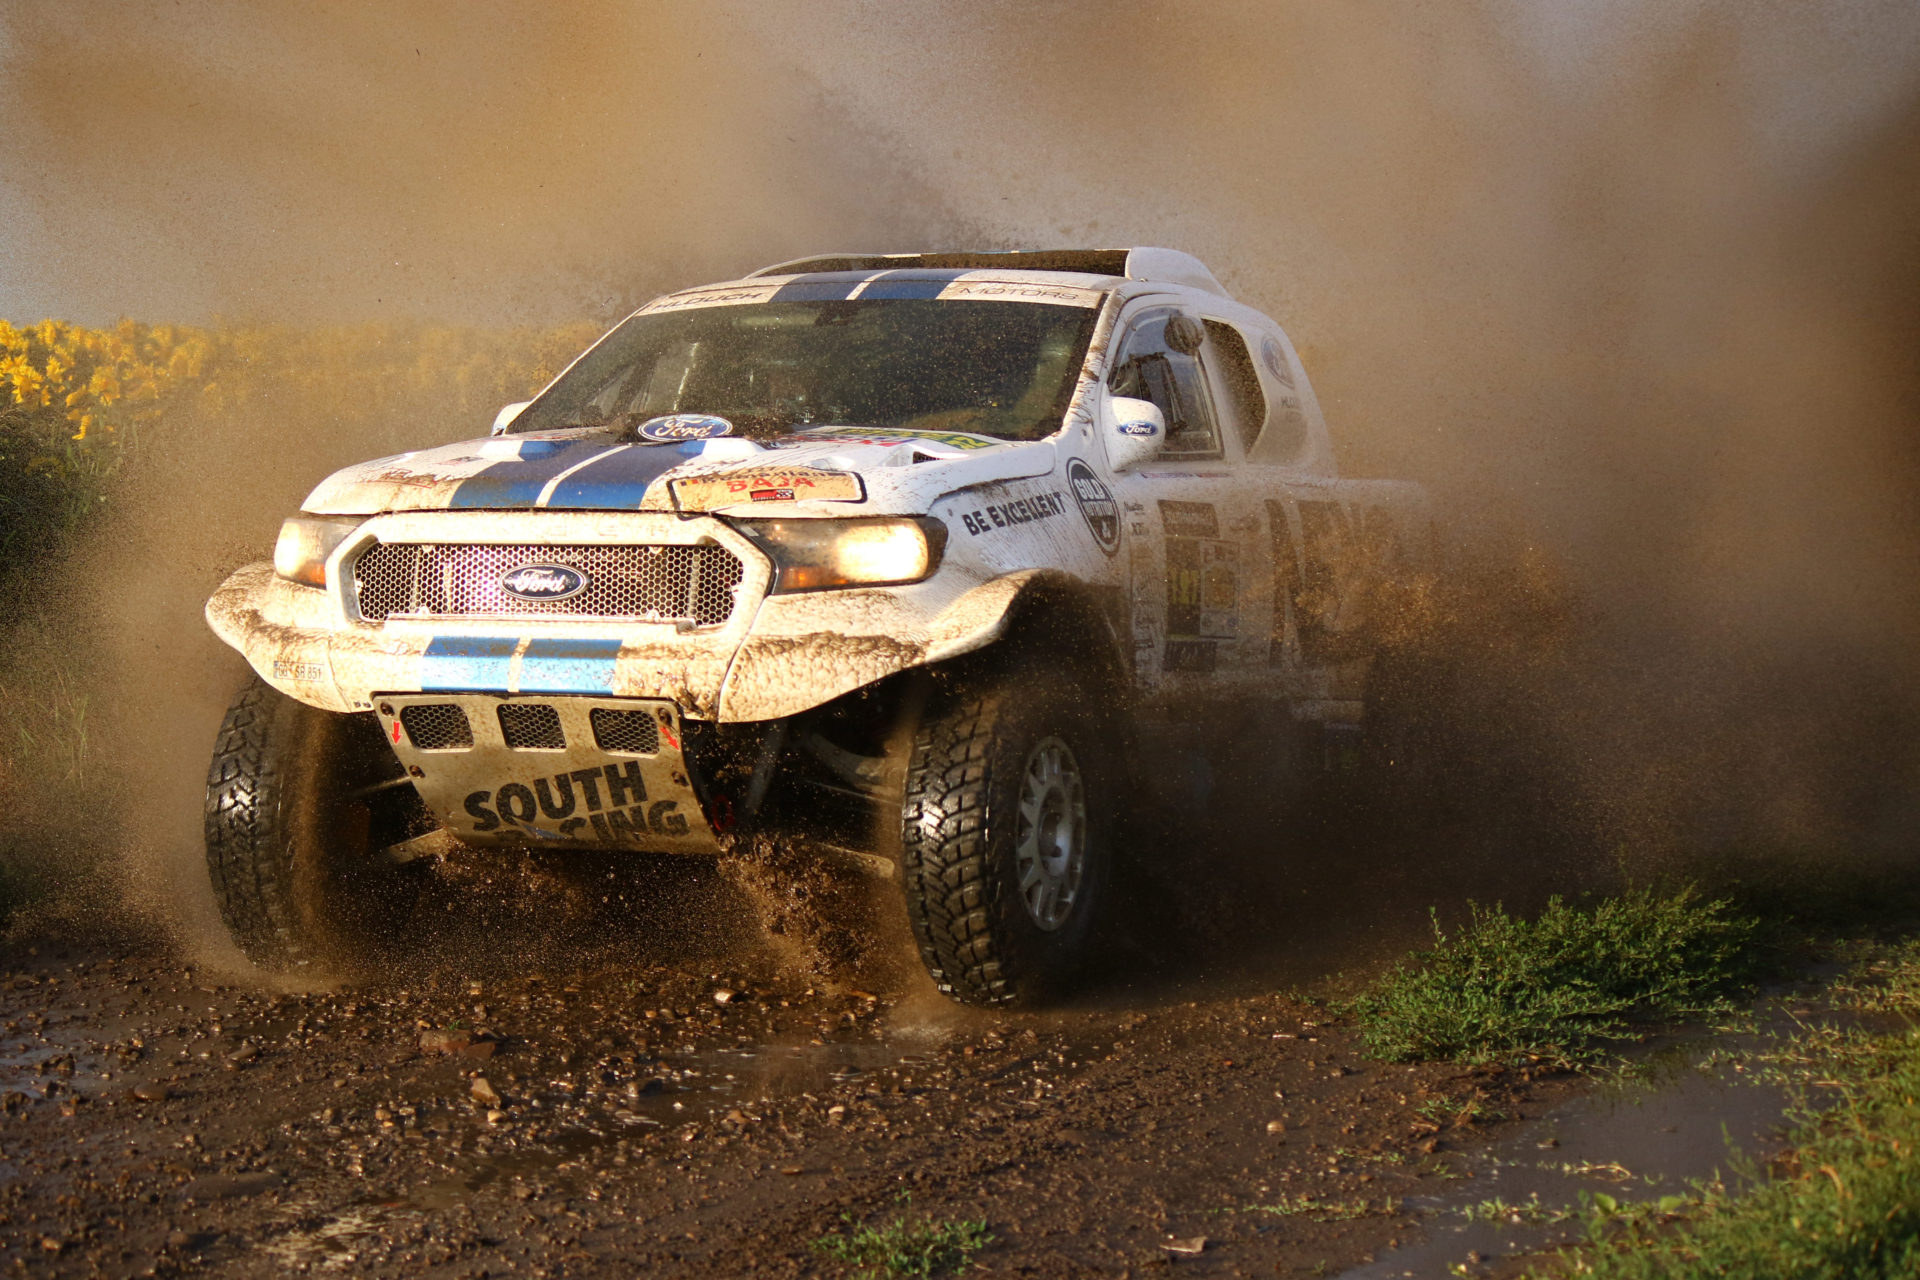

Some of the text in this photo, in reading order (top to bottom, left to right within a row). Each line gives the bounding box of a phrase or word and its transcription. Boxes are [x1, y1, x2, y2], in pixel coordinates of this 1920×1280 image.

[959, 287, 1079, 300] MOTORS
[655, 415, 713, 438] Ford
[1125, 422, 1153, 434] Ford
[727, 476, 816, 493] BAJA
[1073, 478, 1106, 500] GOLD
[962, 511, 991, 536] BE
[987, 492, 1066, 528] EXCELLENT
[513, 569, 566, 593] Ford
[307, 666, 321, 679] 851
[464, 761, 649, 832] SOUTH
